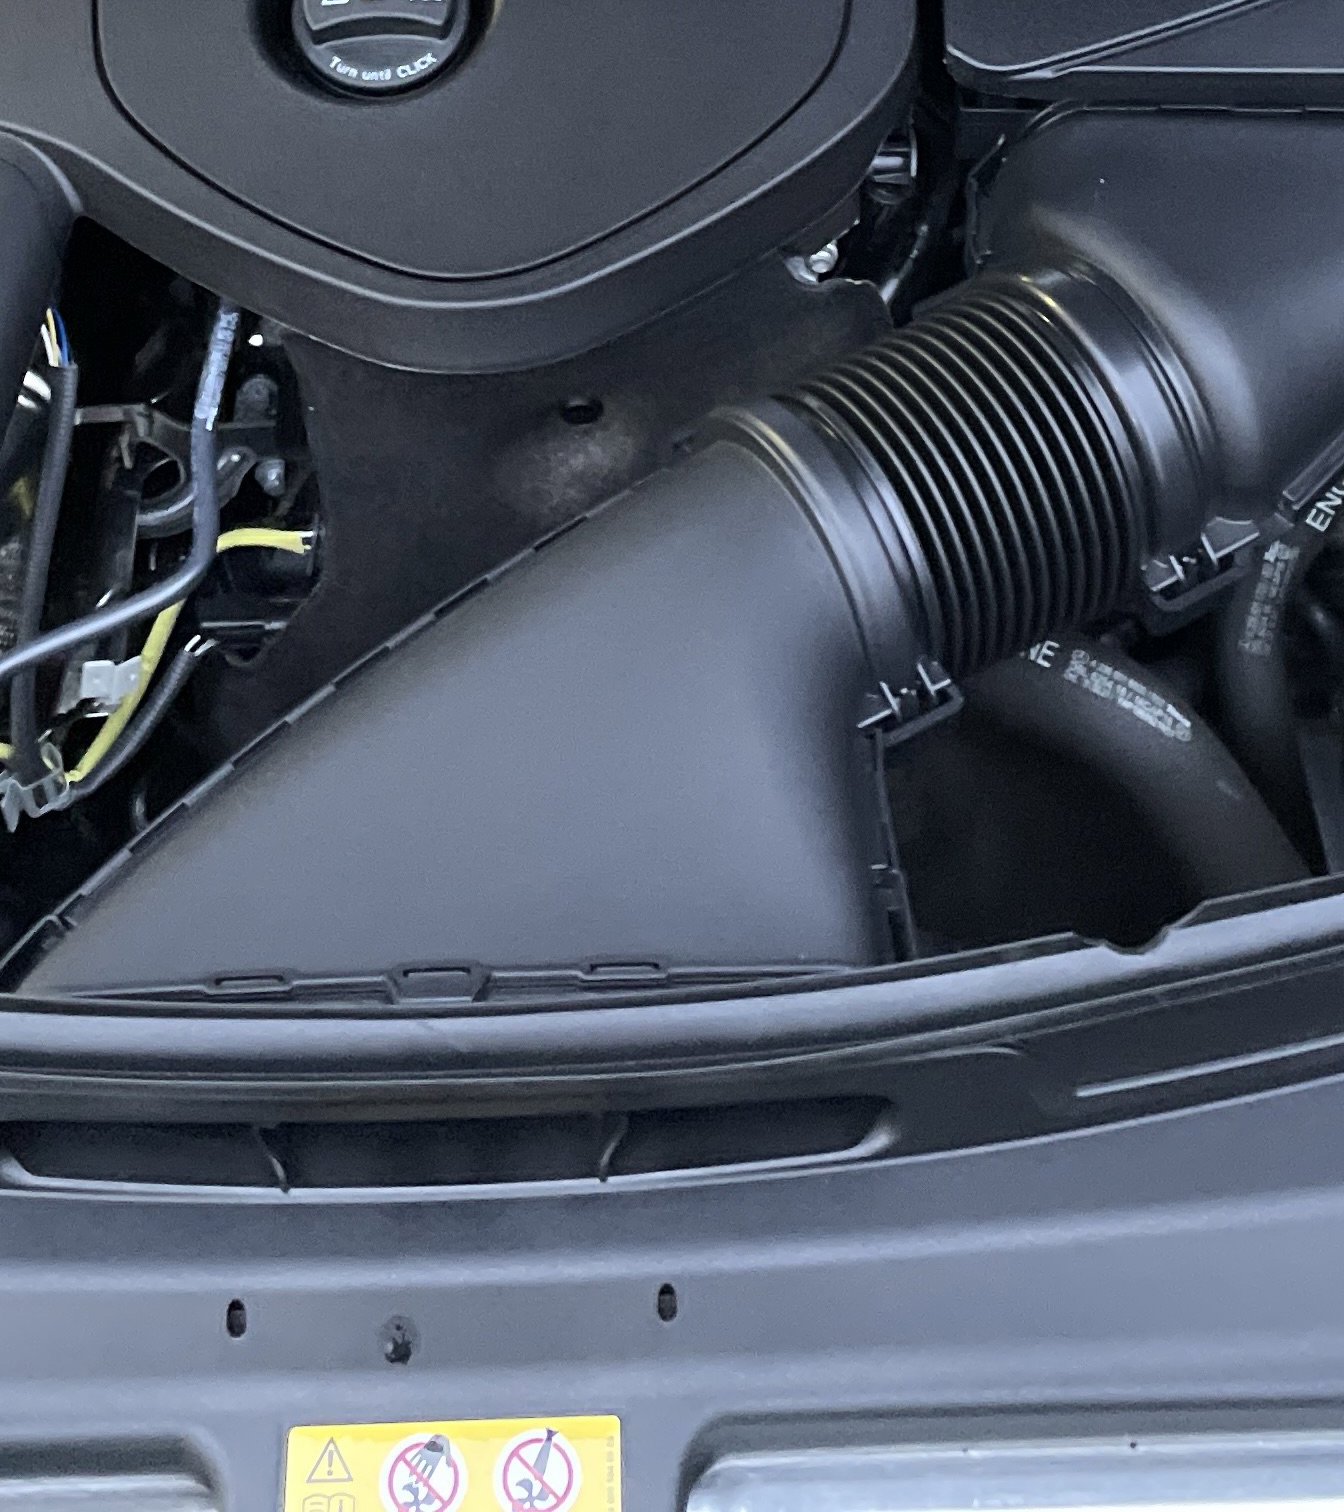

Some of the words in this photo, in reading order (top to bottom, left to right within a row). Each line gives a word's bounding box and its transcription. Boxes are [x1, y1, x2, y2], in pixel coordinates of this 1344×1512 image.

[329, 55, 359, 78] Turn
[361, 68, 392, 81] until
[396, 52, 438, 78] CLICK
